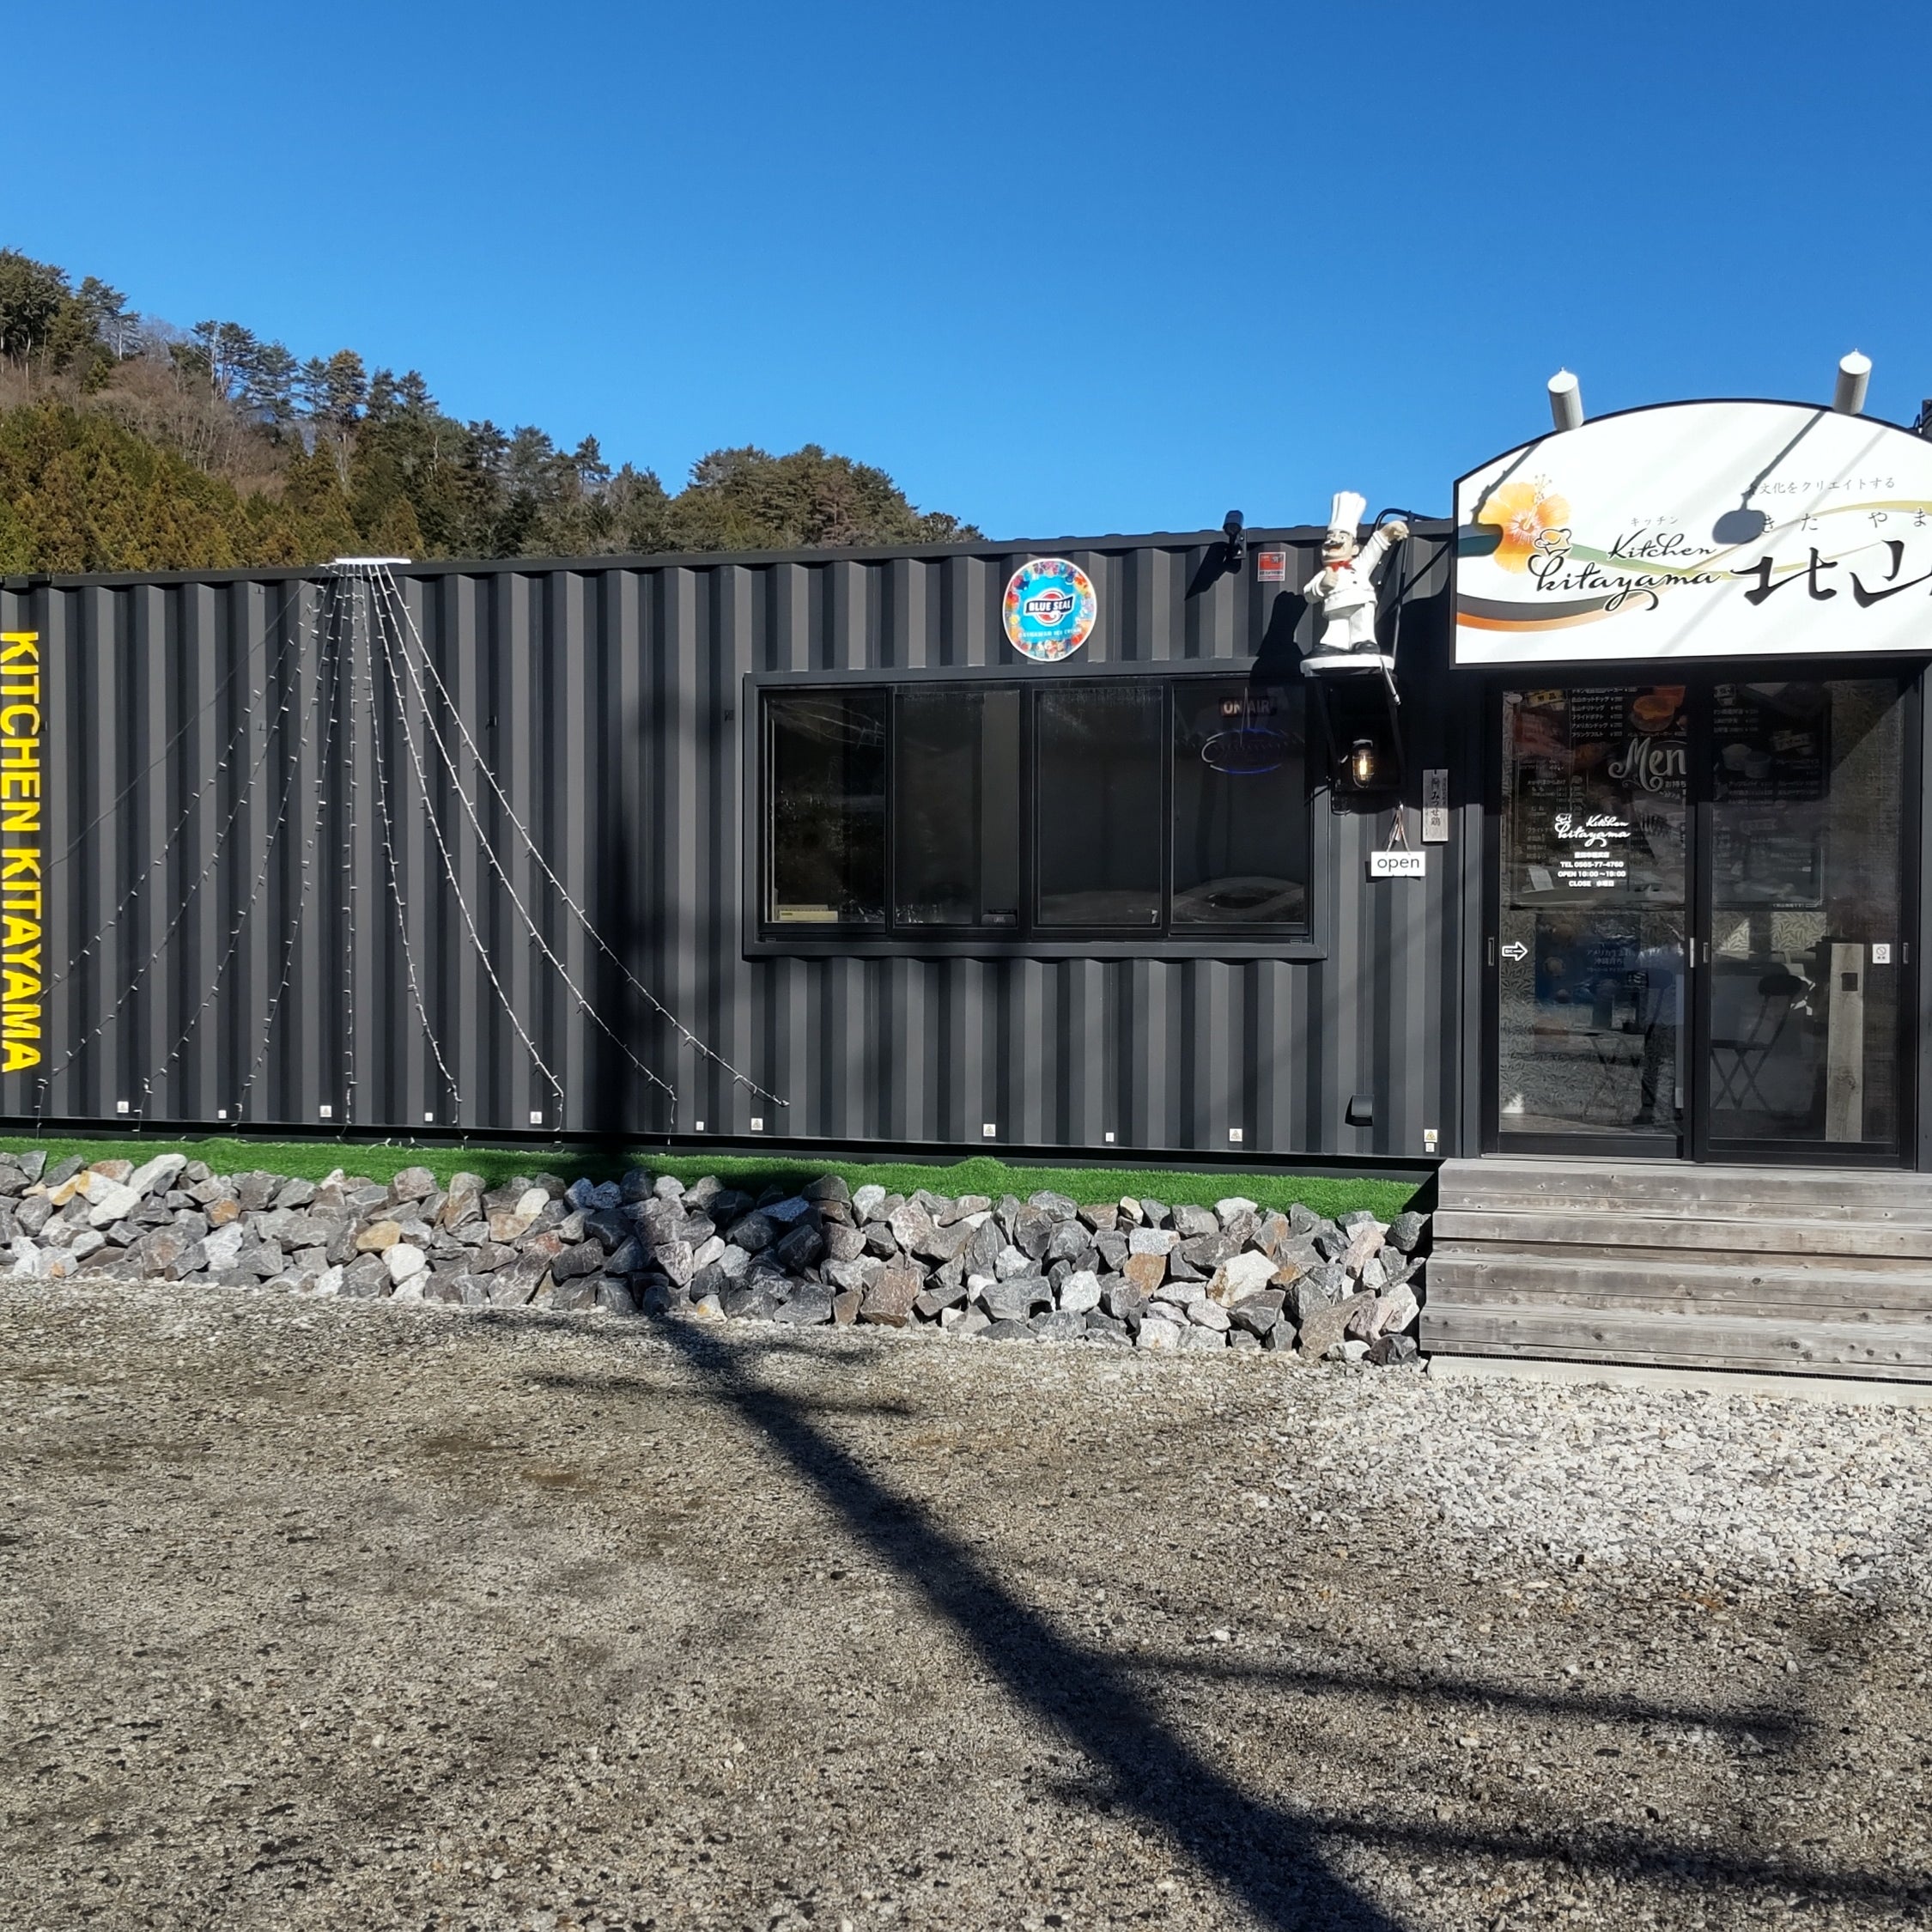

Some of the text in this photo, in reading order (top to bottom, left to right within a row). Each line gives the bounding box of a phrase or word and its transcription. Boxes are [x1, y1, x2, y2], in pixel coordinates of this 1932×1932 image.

[1746, 477, 1895, 495] 文化をクリエイトする
[1631, 516, 1678, 526] キッチン
[1608, 528, 1716, 559] Kitchen
[1028, 599, 1072, 611] BLUE SEAL
[1223, 701, 1242, 714] ON
[0, 632, 40, 831] KITCHEN
[1608, 738, 1686, 792] Men
[1377, 859, 1419, 872] open
[1, 849, 41, 1073] KITAYAMA
